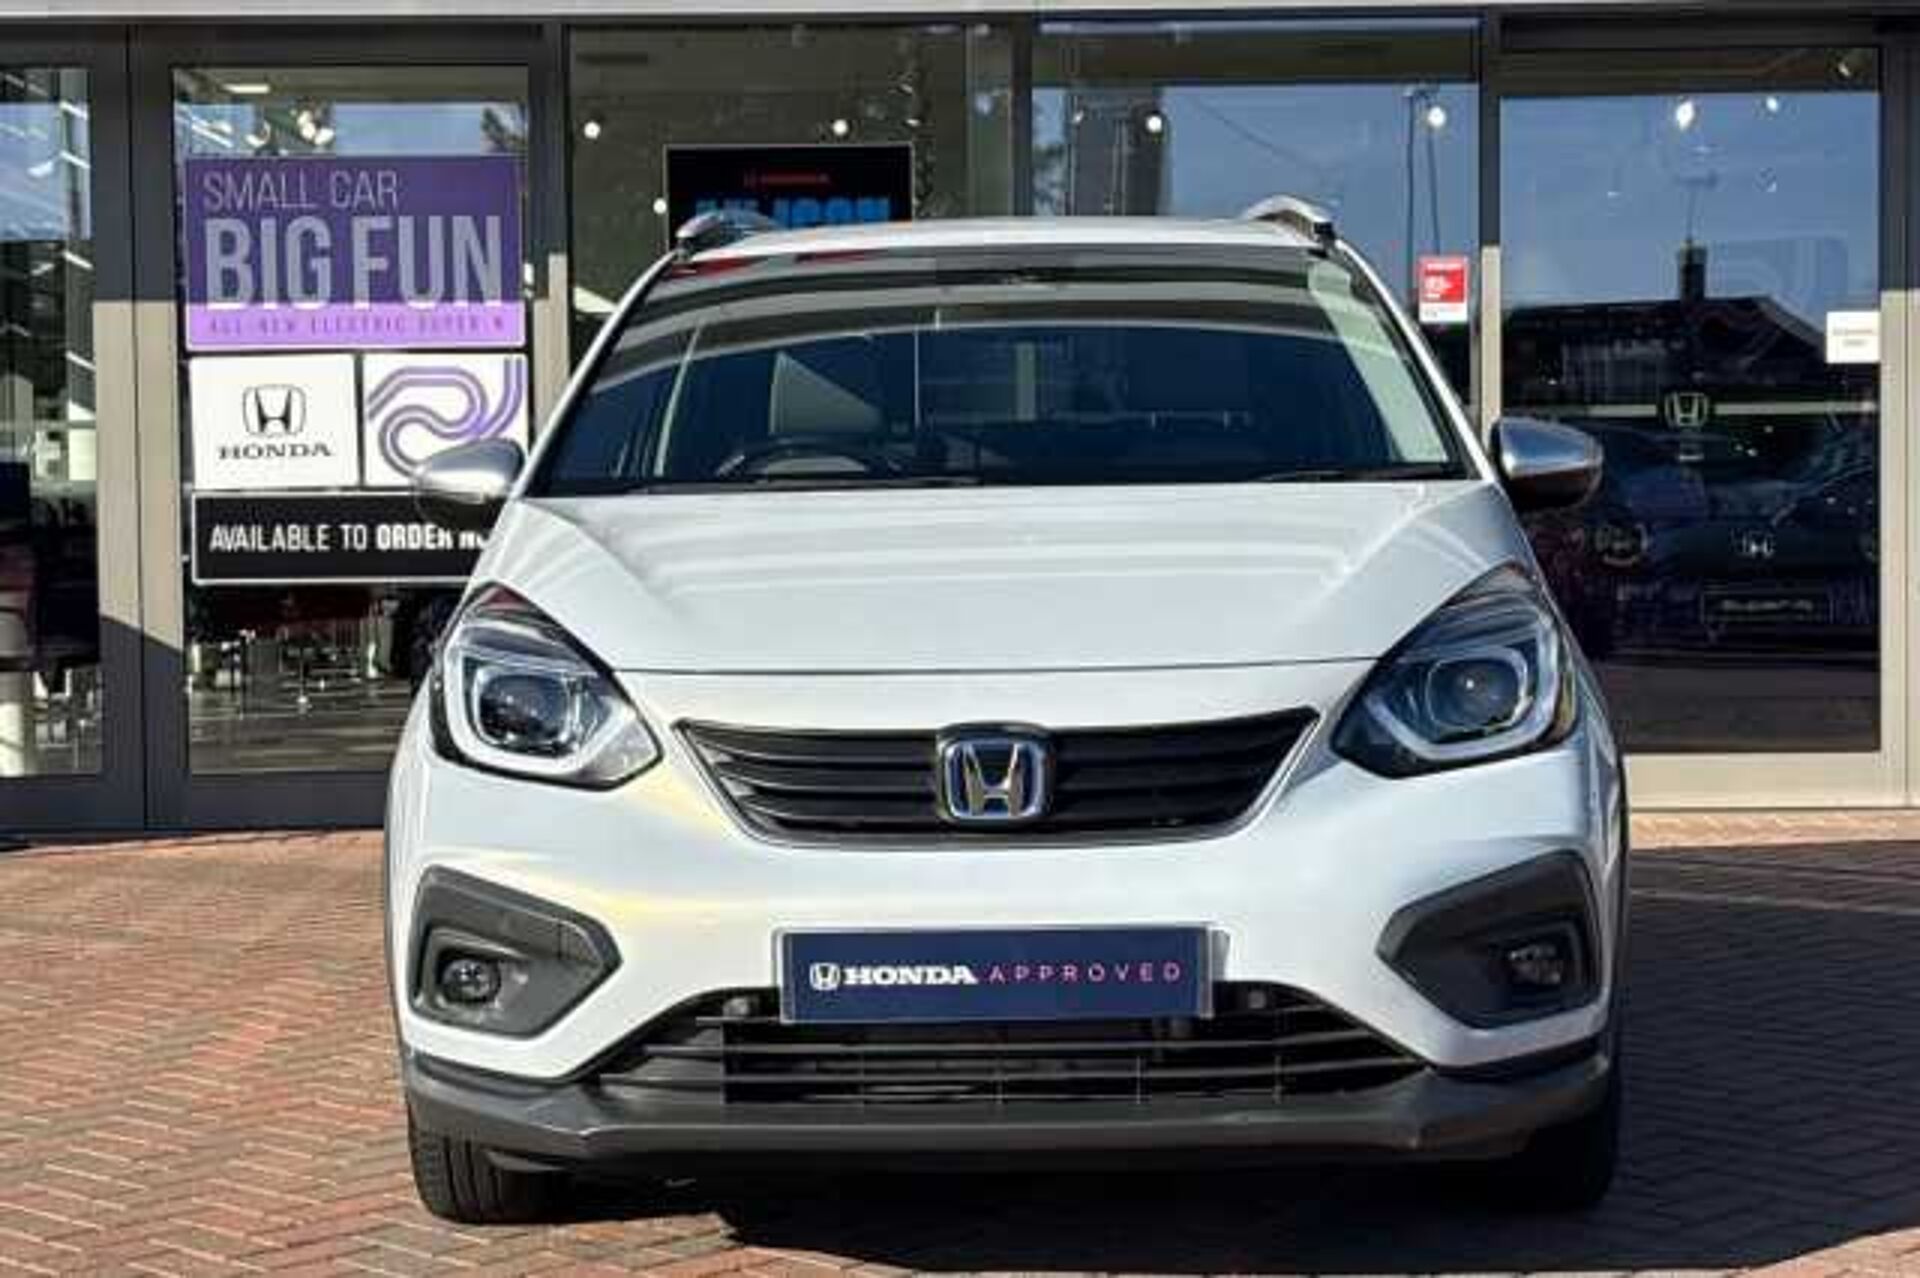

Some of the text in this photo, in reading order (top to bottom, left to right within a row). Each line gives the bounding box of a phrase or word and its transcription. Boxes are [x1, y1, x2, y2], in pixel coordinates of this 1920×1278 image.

[203, 170, 399, 211] SMALL CAR
[205, 215, 501, 310] BIG FUN
[218, 441, 332, 460] HONDA
[210, 523, 331, 551] AVAILABLE
[340, 523, 367, 550] TO
[844, 963, 979, 986] HONDA
[989, 962, 1181, 984] APPROVED
